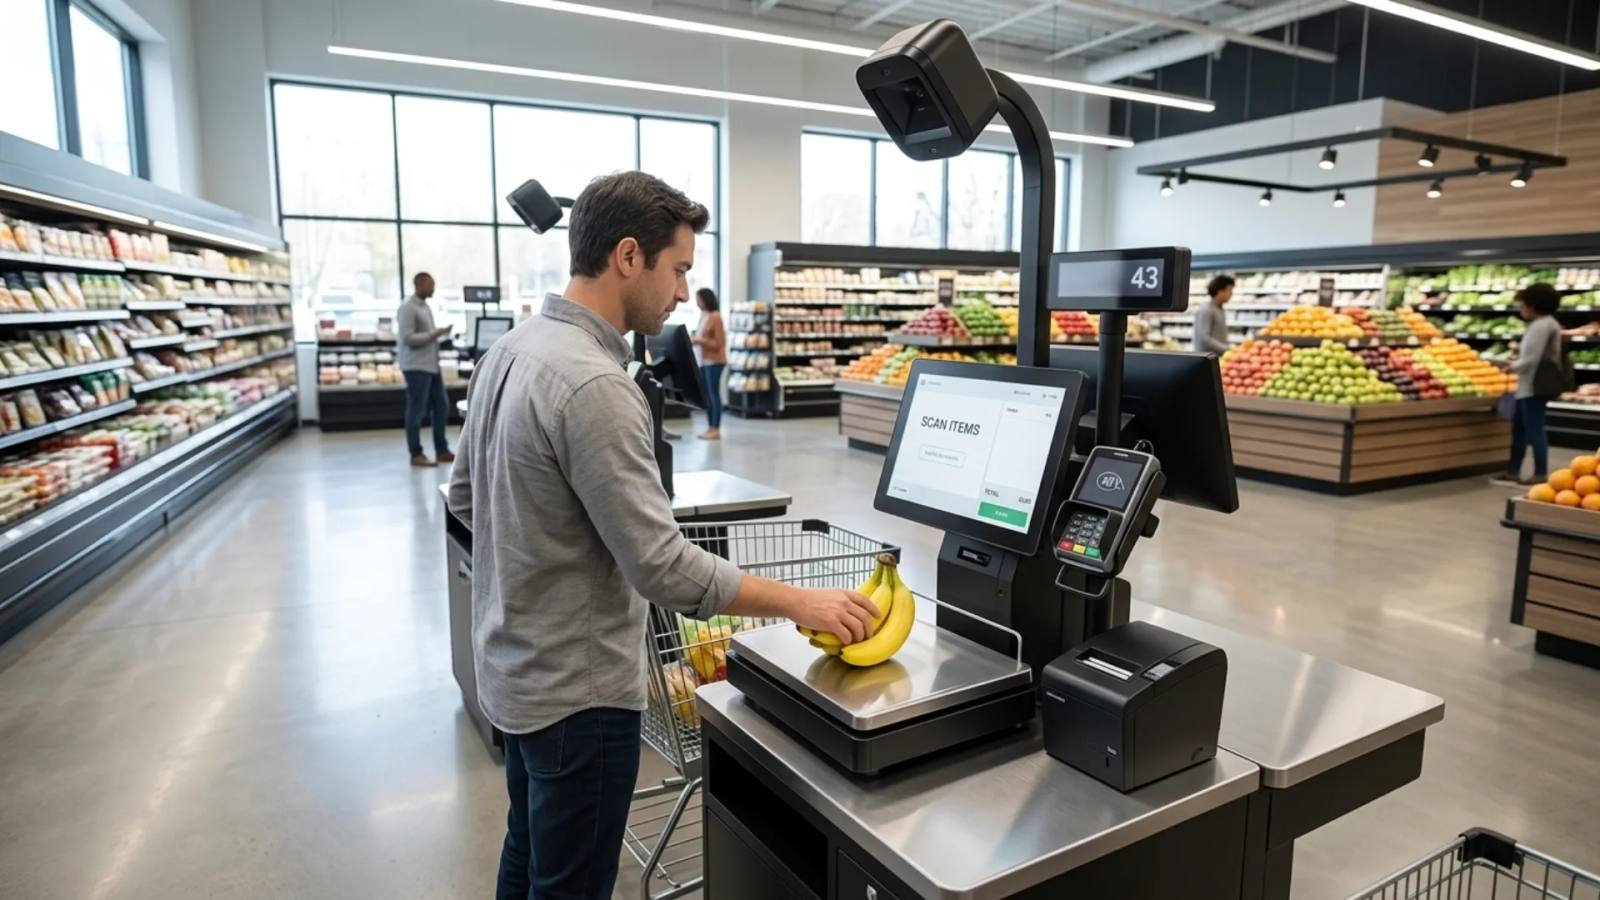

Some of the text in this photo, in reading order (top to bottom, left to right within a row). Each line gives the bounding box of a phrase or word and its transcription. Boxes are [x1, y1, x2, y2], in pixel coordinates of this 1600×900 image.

[1131, 266, 1158, 289] 43
[921, 415, 981, 436] SCAN ITEMS
